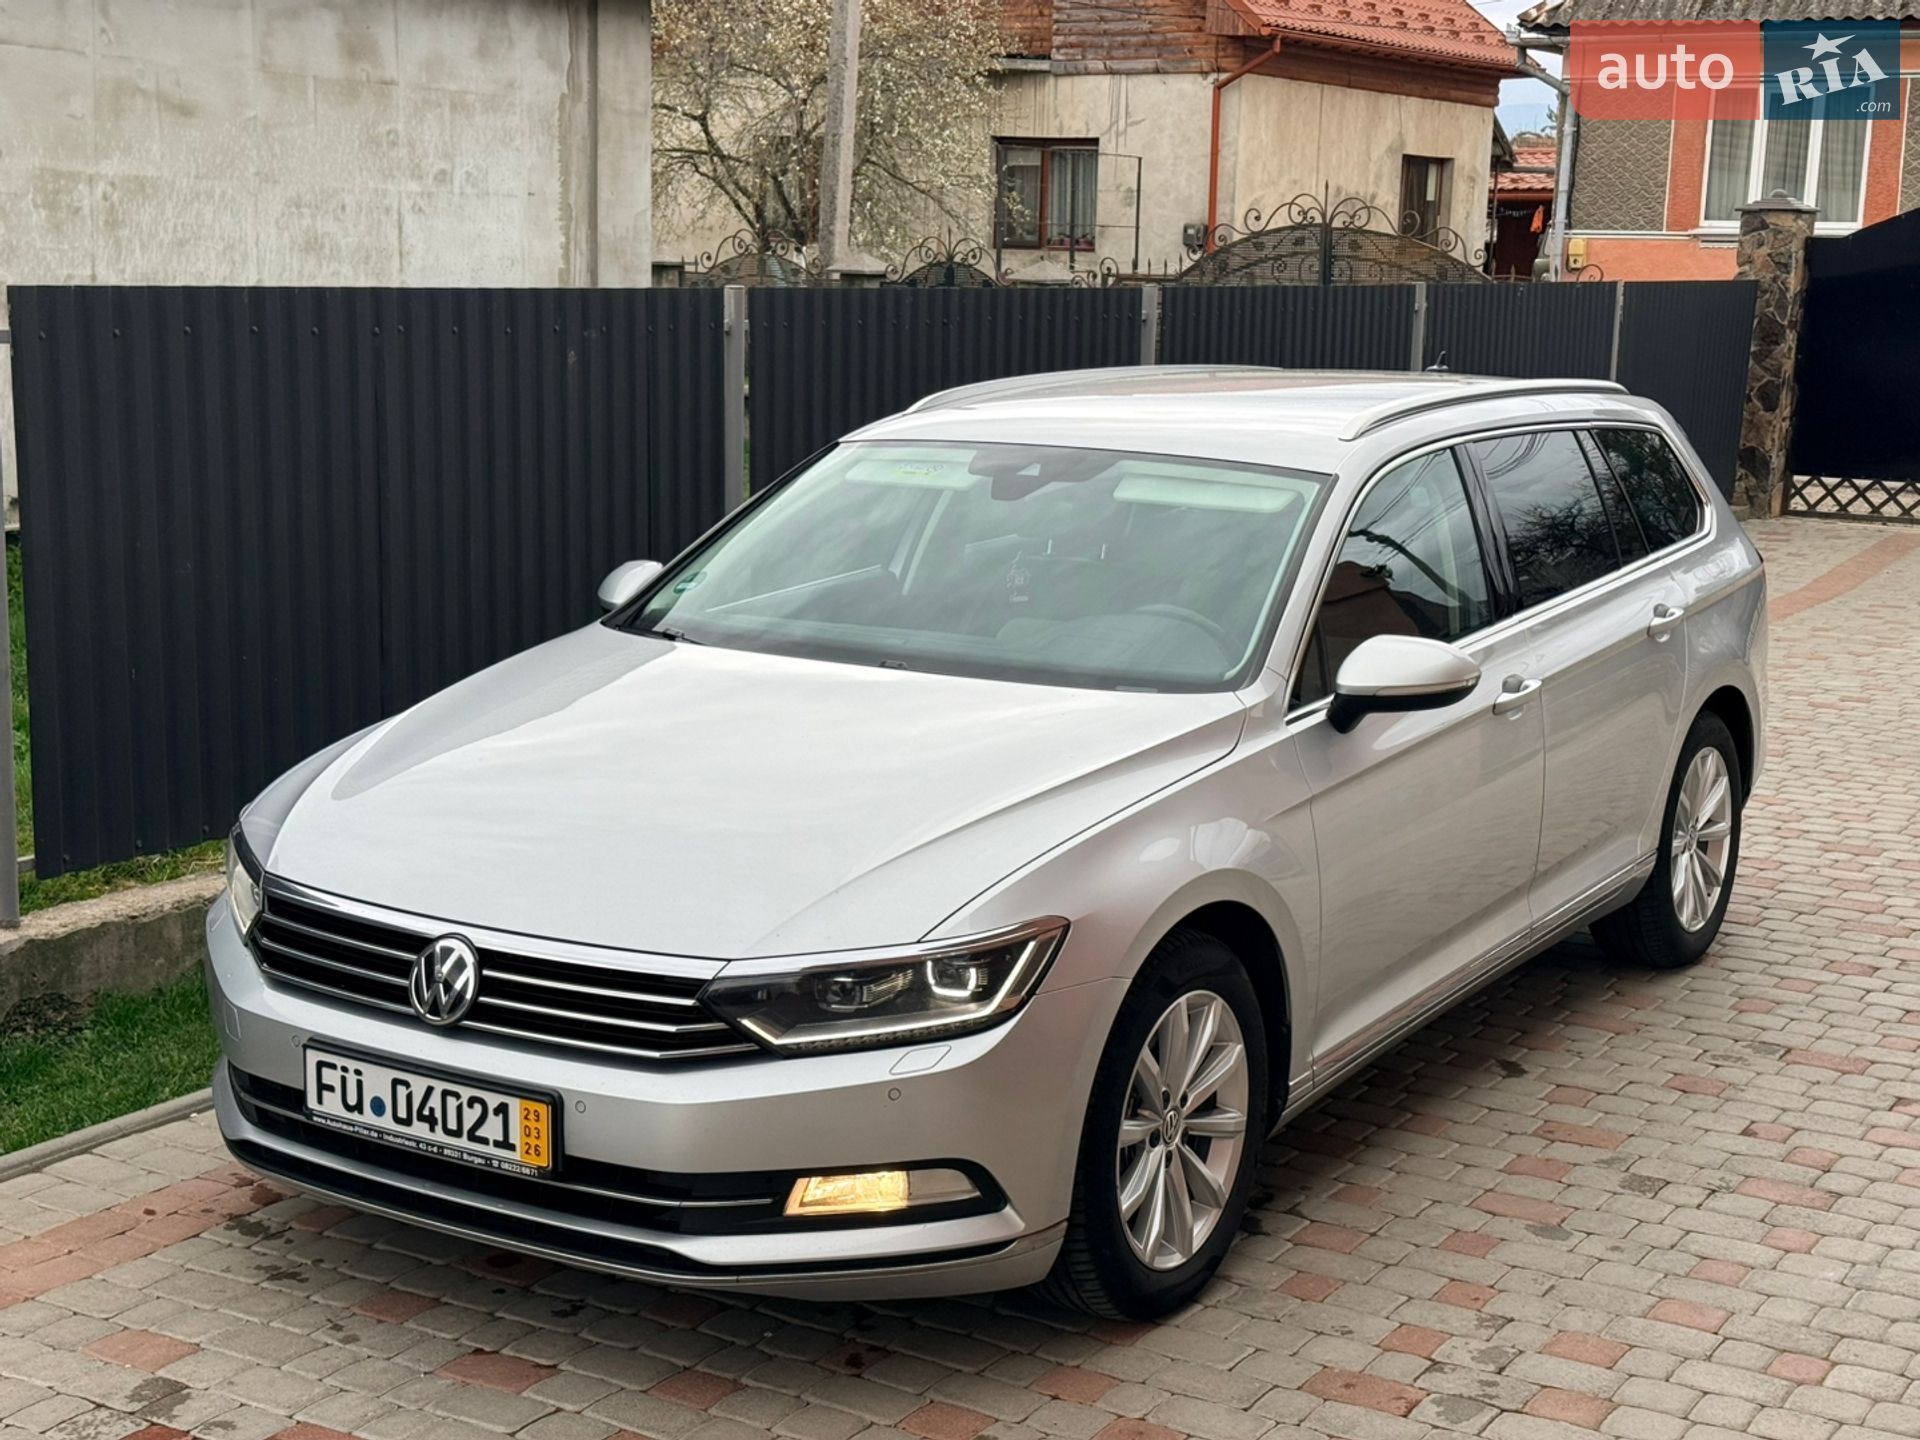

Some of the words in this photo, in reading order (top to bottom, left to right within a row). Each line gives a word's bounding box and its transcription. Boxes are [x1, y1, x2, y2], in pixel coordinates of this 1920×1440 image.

[315, 1059, 364, 1116] FÜ
[391, 1076, 517, 1153] 04021
[523, 1106, 541, 1123] 29
[524, 1124, 540, 1140] 03
[524, 1141, 542, 1157] 26
